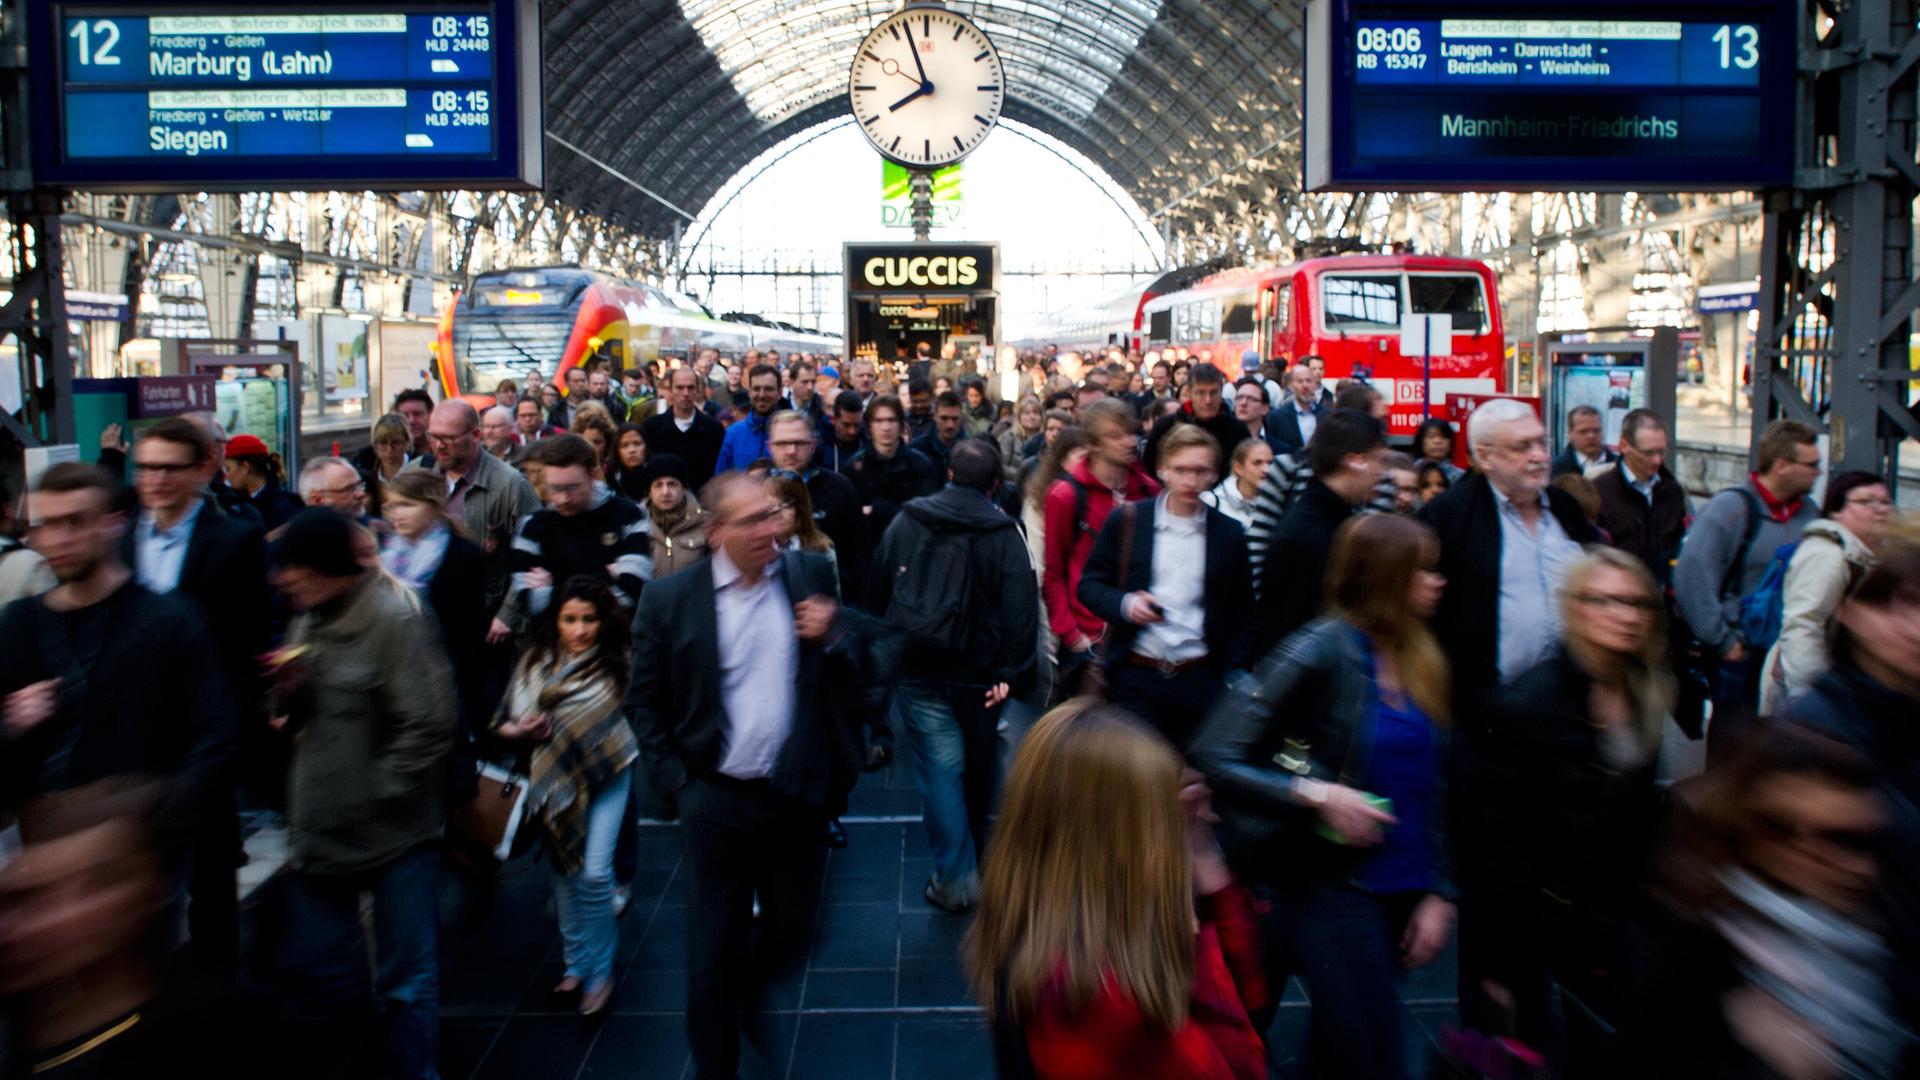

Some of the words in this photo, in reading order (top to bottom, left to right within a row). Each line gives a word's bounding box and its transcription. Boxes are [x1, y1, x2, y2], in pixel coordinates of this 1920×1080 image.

[355, 17, 390, 28] nach
[432, 16, 489, 37] 08:15
[1547, 23, 1572, 37] Zug
[69, 20, 121, 66] 12
[149, 36, 207, 51] Friedberg
[224, 36, 266, 48] Gießen
[1357, 27, 1422, 52] 08:06
[1712, 25, 1760, 69] 13
[1357, 54, 1378, 69] RB
[1384, 54, 1427, 69] 15347
[1441, 42, 1493, 61] Langen
[1514, 42, 1593, 58] Darmstadt
[149, 51, 251, 81] Marburg
[262, 50, 333, 76] (Lahn)
[1447, 59, 1518, 75] Bensheim
[1540, 61, 1611, 76] Weinheim
[432, 91, 489, 112] 08:15
[149, 110, 207, 125] Friedberg
[224, 109, 266, 122] Gießen
[282, 109, 333, 122] Wetzlar
[1442, 114, 1679, 138] Mannheim-Friedrichs
[149, 126, 228, 156] Siegen
[881, 205, 961, 225] DAEV
[864, 256, 978, 287] CUCCIS
[1400, 383, 1425, 399] DB
